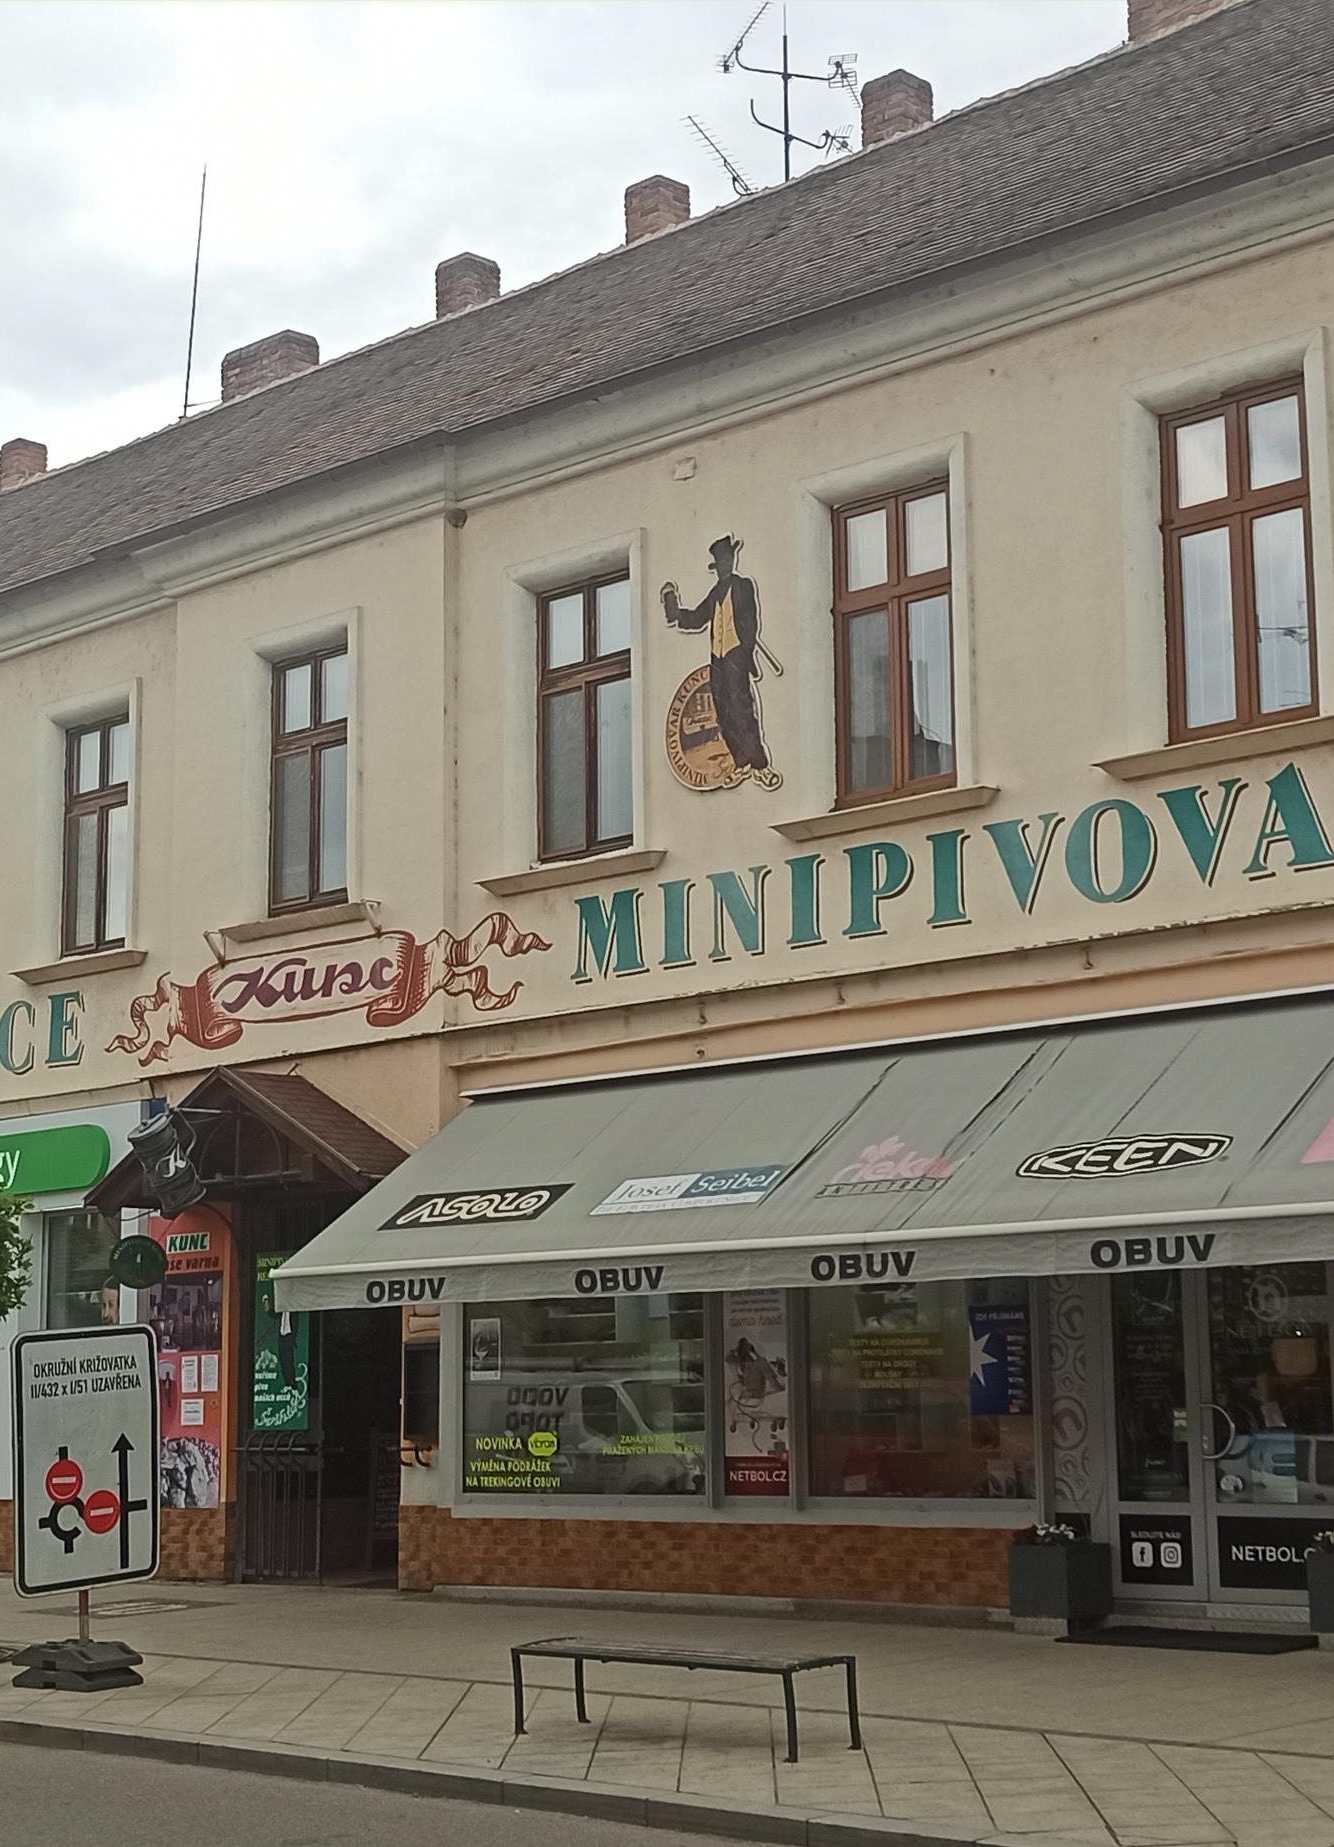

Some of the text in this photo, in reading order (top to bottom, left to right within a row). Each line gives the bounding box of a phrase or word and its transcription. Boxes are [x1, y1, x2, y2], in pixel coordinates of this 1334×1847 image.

[213, 957, 402, 1013] Kunc
[830, 1151, 955, 1183] riek
[1030, 1140, 1222, 1175] KEEN
[617, 1169, 782, 1201] Josef Seibel
[395, 1190, 552, 1226] ASOLO
[168, 1233, 208, 1252] KUNC
[1089, 1233, 1217, 1270] OBUV
[574, 1265, 665, 1294] OBUV
[810, 1250, 917, 1282] OBUV
[366, 1276, 447, 1303] OBUV
[33, 1356, 77, 1379] OKRUŽNÍ
[30, 1382, 60, 1400] II/432
[70, 1379, 88, 1395] I/51
[91, 1373, 142, 1393] UZAVŘENA
[475, 1437, 523, 1450] NOVINKA
[470, 1459, 552, 1473] VÝMĚNA PODRÁŽEK
[465, 1474, 561, 1488] NA TREKINGOVÉ OBUVI
[1231, 1545, 1317, 1564] NETBOL.C
